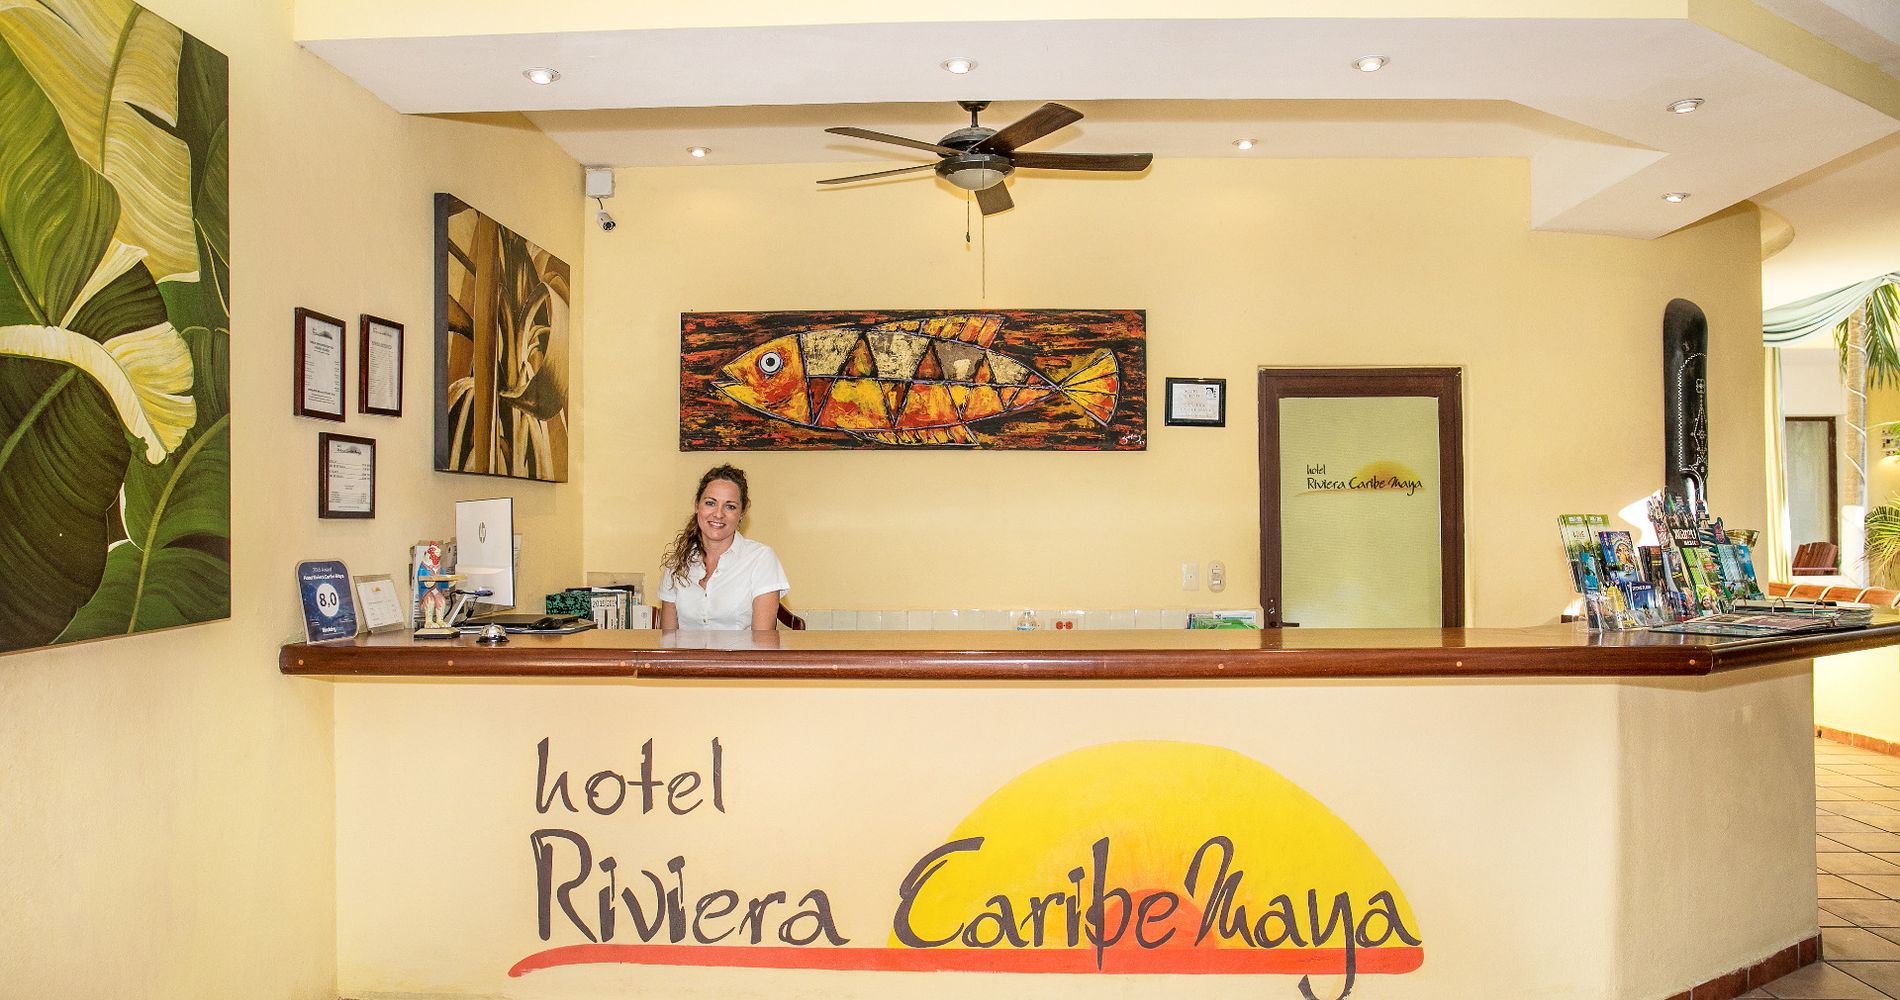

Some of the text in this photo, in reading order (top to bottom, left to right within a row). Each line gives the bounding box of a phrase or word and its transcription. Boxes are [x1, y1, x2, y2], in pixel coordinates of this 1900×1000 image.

[1306, 464, 1326, 475] hotel
[1307, 475, 1423, 497] Riviera Caribe Maya
[536, 737, 726, 814] hotel
[530, 829, 1422, 1000] Riviera Caribe Maya
